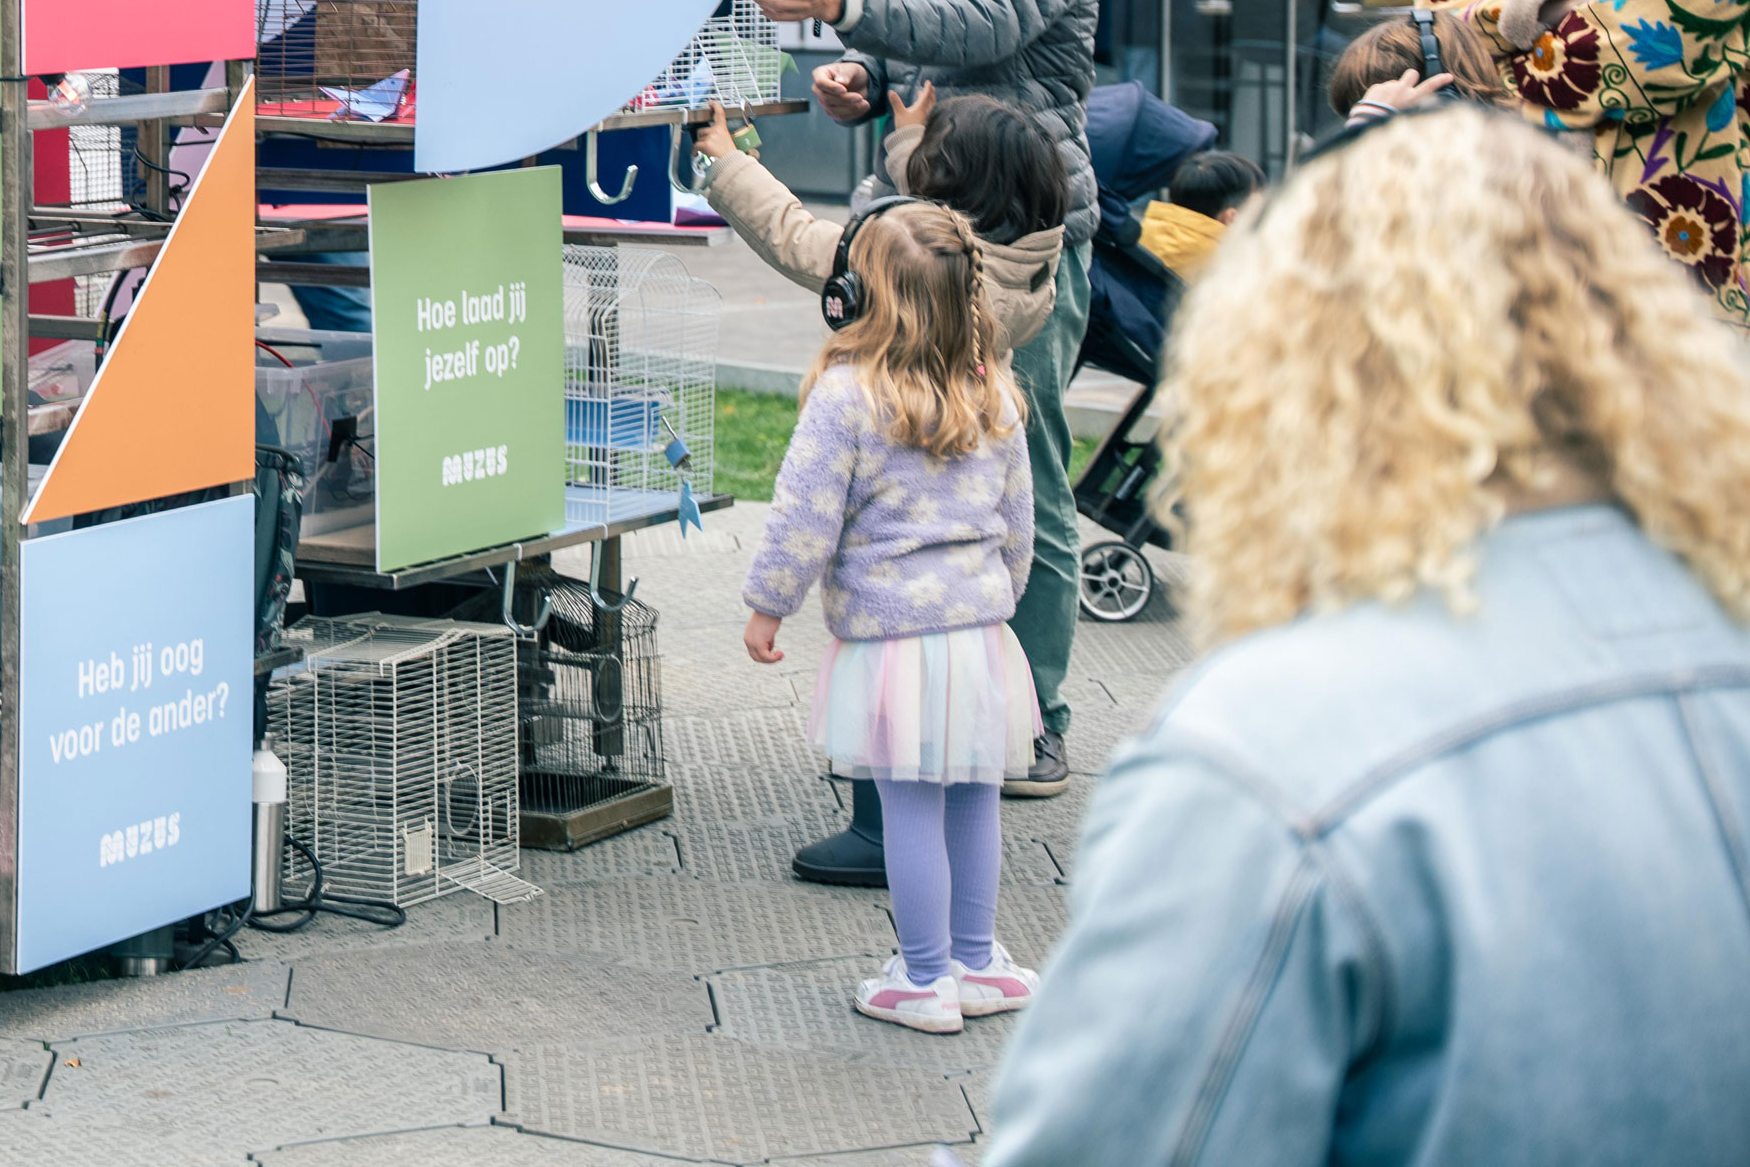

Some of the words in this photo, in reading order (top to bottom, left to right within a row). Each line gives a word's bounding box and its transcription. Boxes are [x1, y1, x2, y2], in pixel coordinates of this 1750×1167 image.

[417, 298, 456, 332] Hoe
[462, 284, 504, 325] laad
[508, 282, 526, 324] jij
[424, 340, 479, 391] jezelf
[485, 336, 520, 378] op?
[442, 444, 507, 487] MUZUS
[78, 652, 125, 698] Heb
[130, 642, 153, 692] jij
[161, 638, 204, 677] oog
[50, 721, 103, 764] voor
[111, 707, 140, 747] de
[149, 681, 229, 736] ander?
[100, 812, 180, 868] MUZUS
